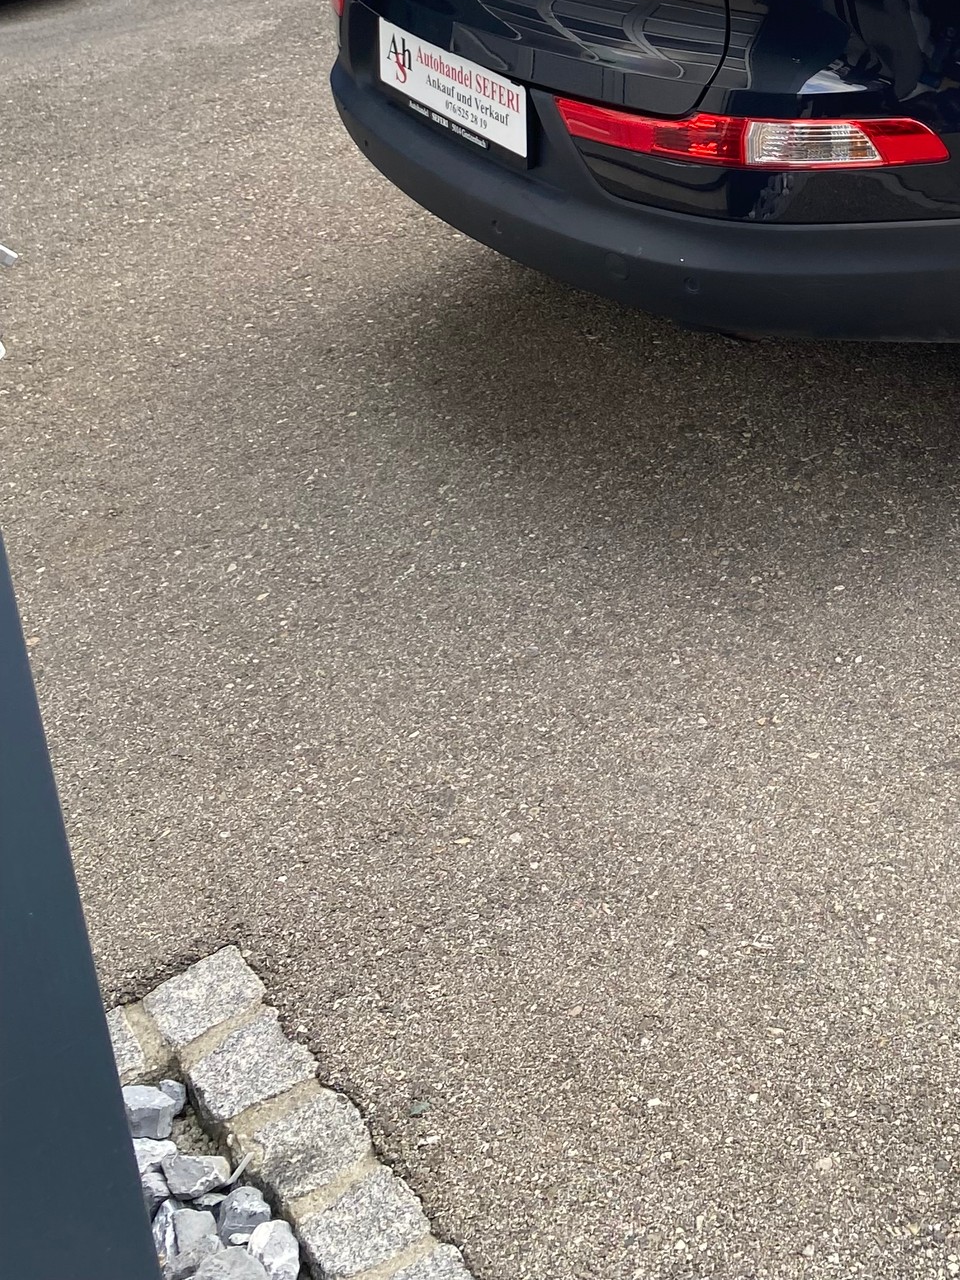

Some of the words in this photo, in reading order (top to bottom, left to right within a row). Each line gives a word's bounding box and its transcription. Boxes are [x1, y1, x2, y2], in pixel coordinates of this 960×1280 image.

[416, 45, 472, 89] Autohandel
[475, 73, 520, 113] SEFERI
[426, 73, 455, 98] Ankauf
[457, 92, 472, 107] und
[474, 97, 510, 126] Verkauf
[480, 118, 488, 130] 19
